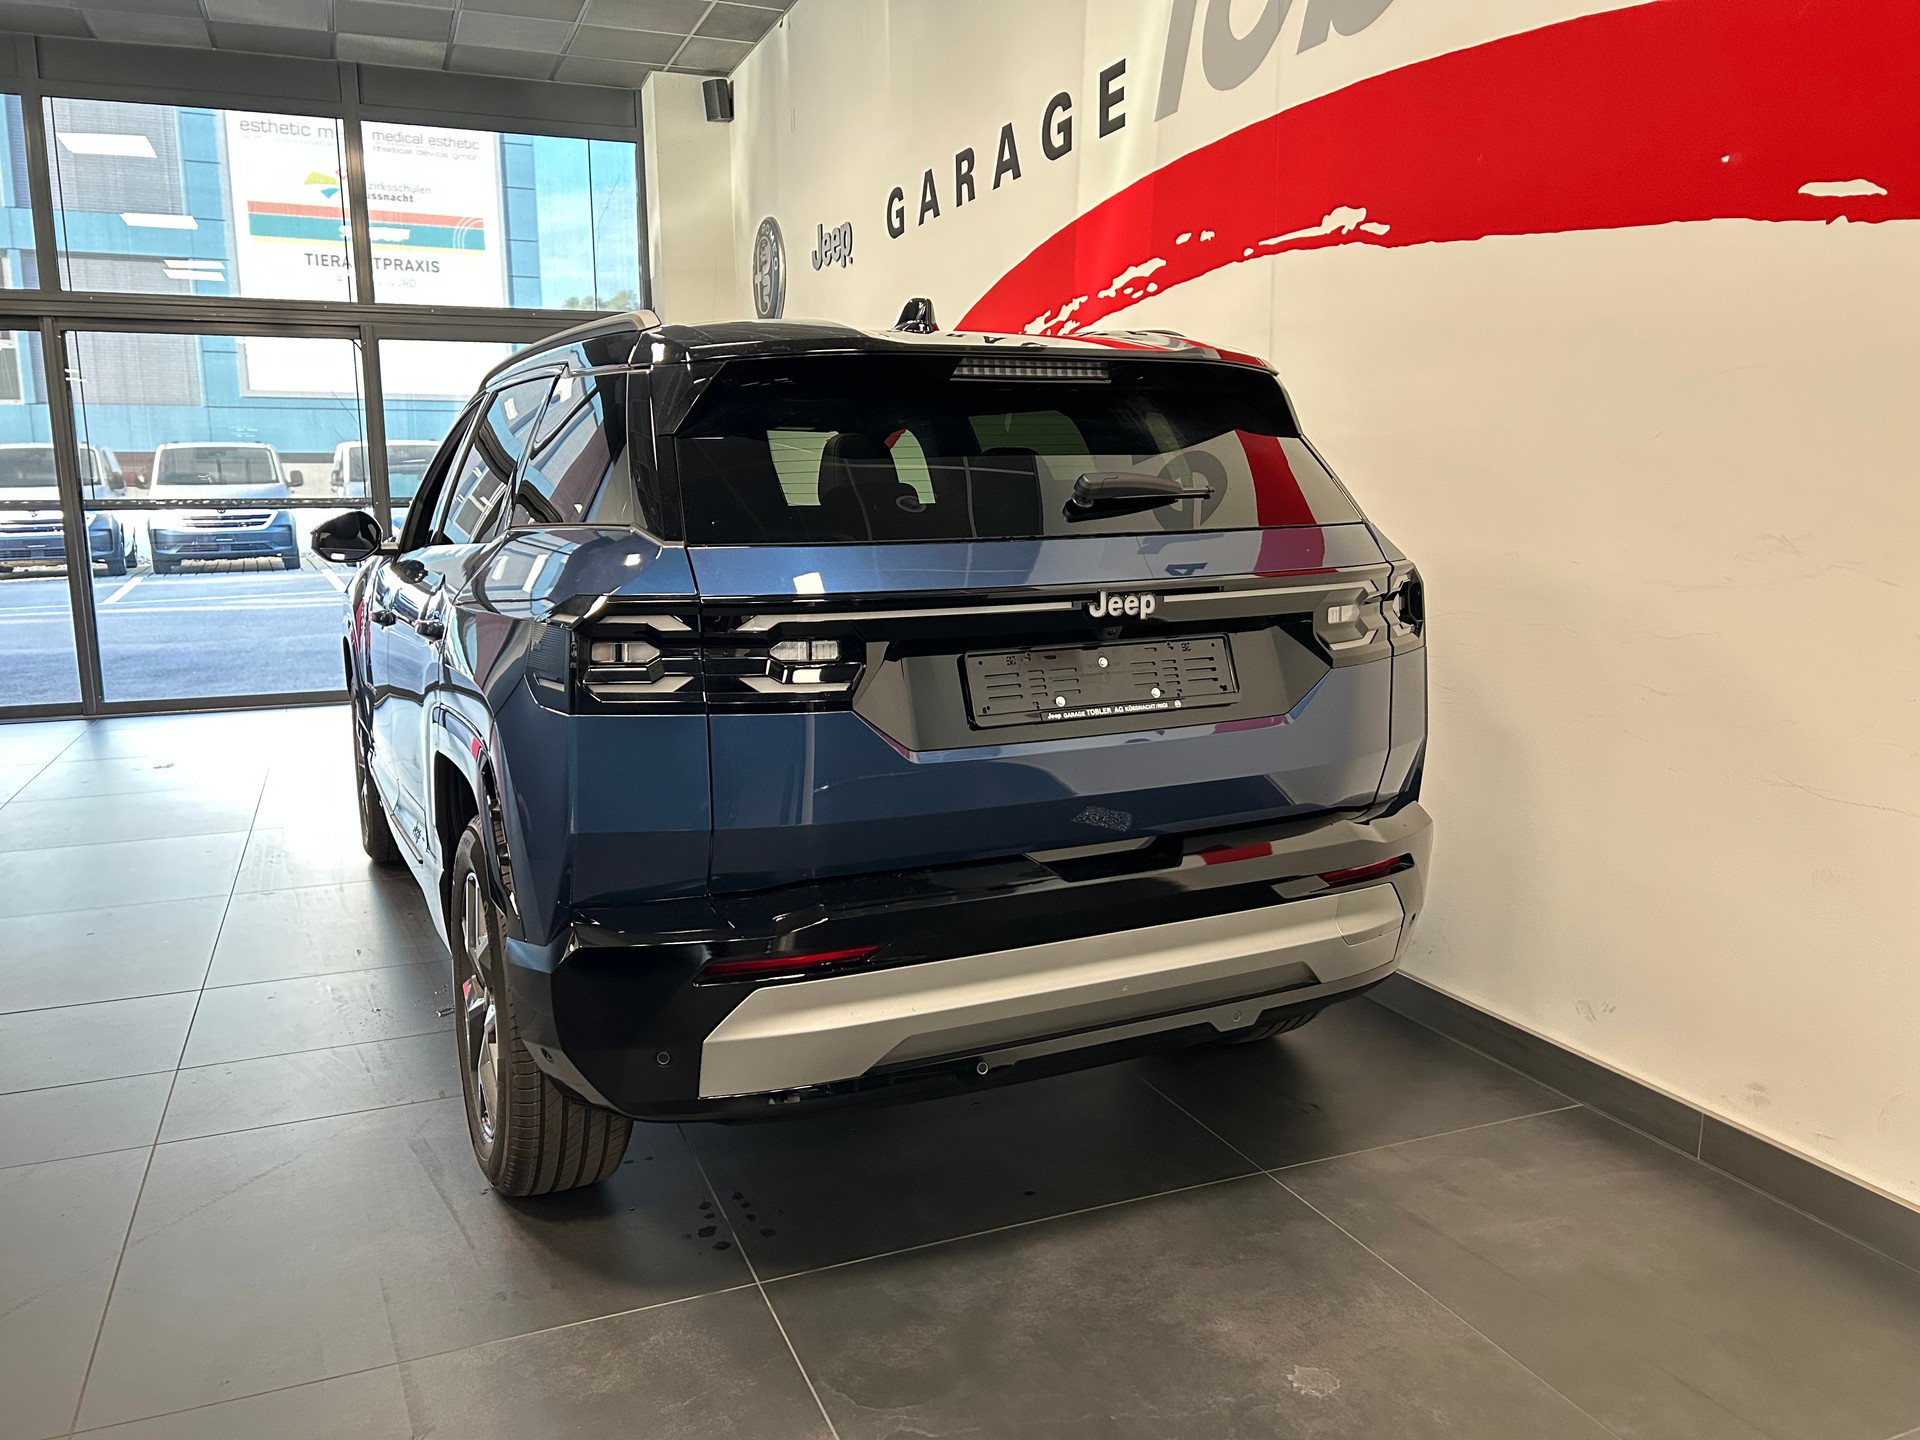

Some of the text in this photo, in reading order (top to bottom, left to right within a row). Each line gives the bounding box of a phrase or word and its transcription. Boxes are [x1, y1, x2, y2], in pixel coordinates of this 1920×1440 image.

[239, 119, 311, 136] esthetic
[371, 131, 480, 150] medical esthetic
[886, 58, 1127, 239] GARAGE
[304, 253, 441, 273] TIERATPRAXIS
[1089, 590, 1156, 619] Jeep
[1047, 712, 1062, 720] Jeep
[1063, 710, 1086, 719] GARAGE
[1085, 707, 1112, 716] TOBLER
[1114, 705, 1125, 714] AG
